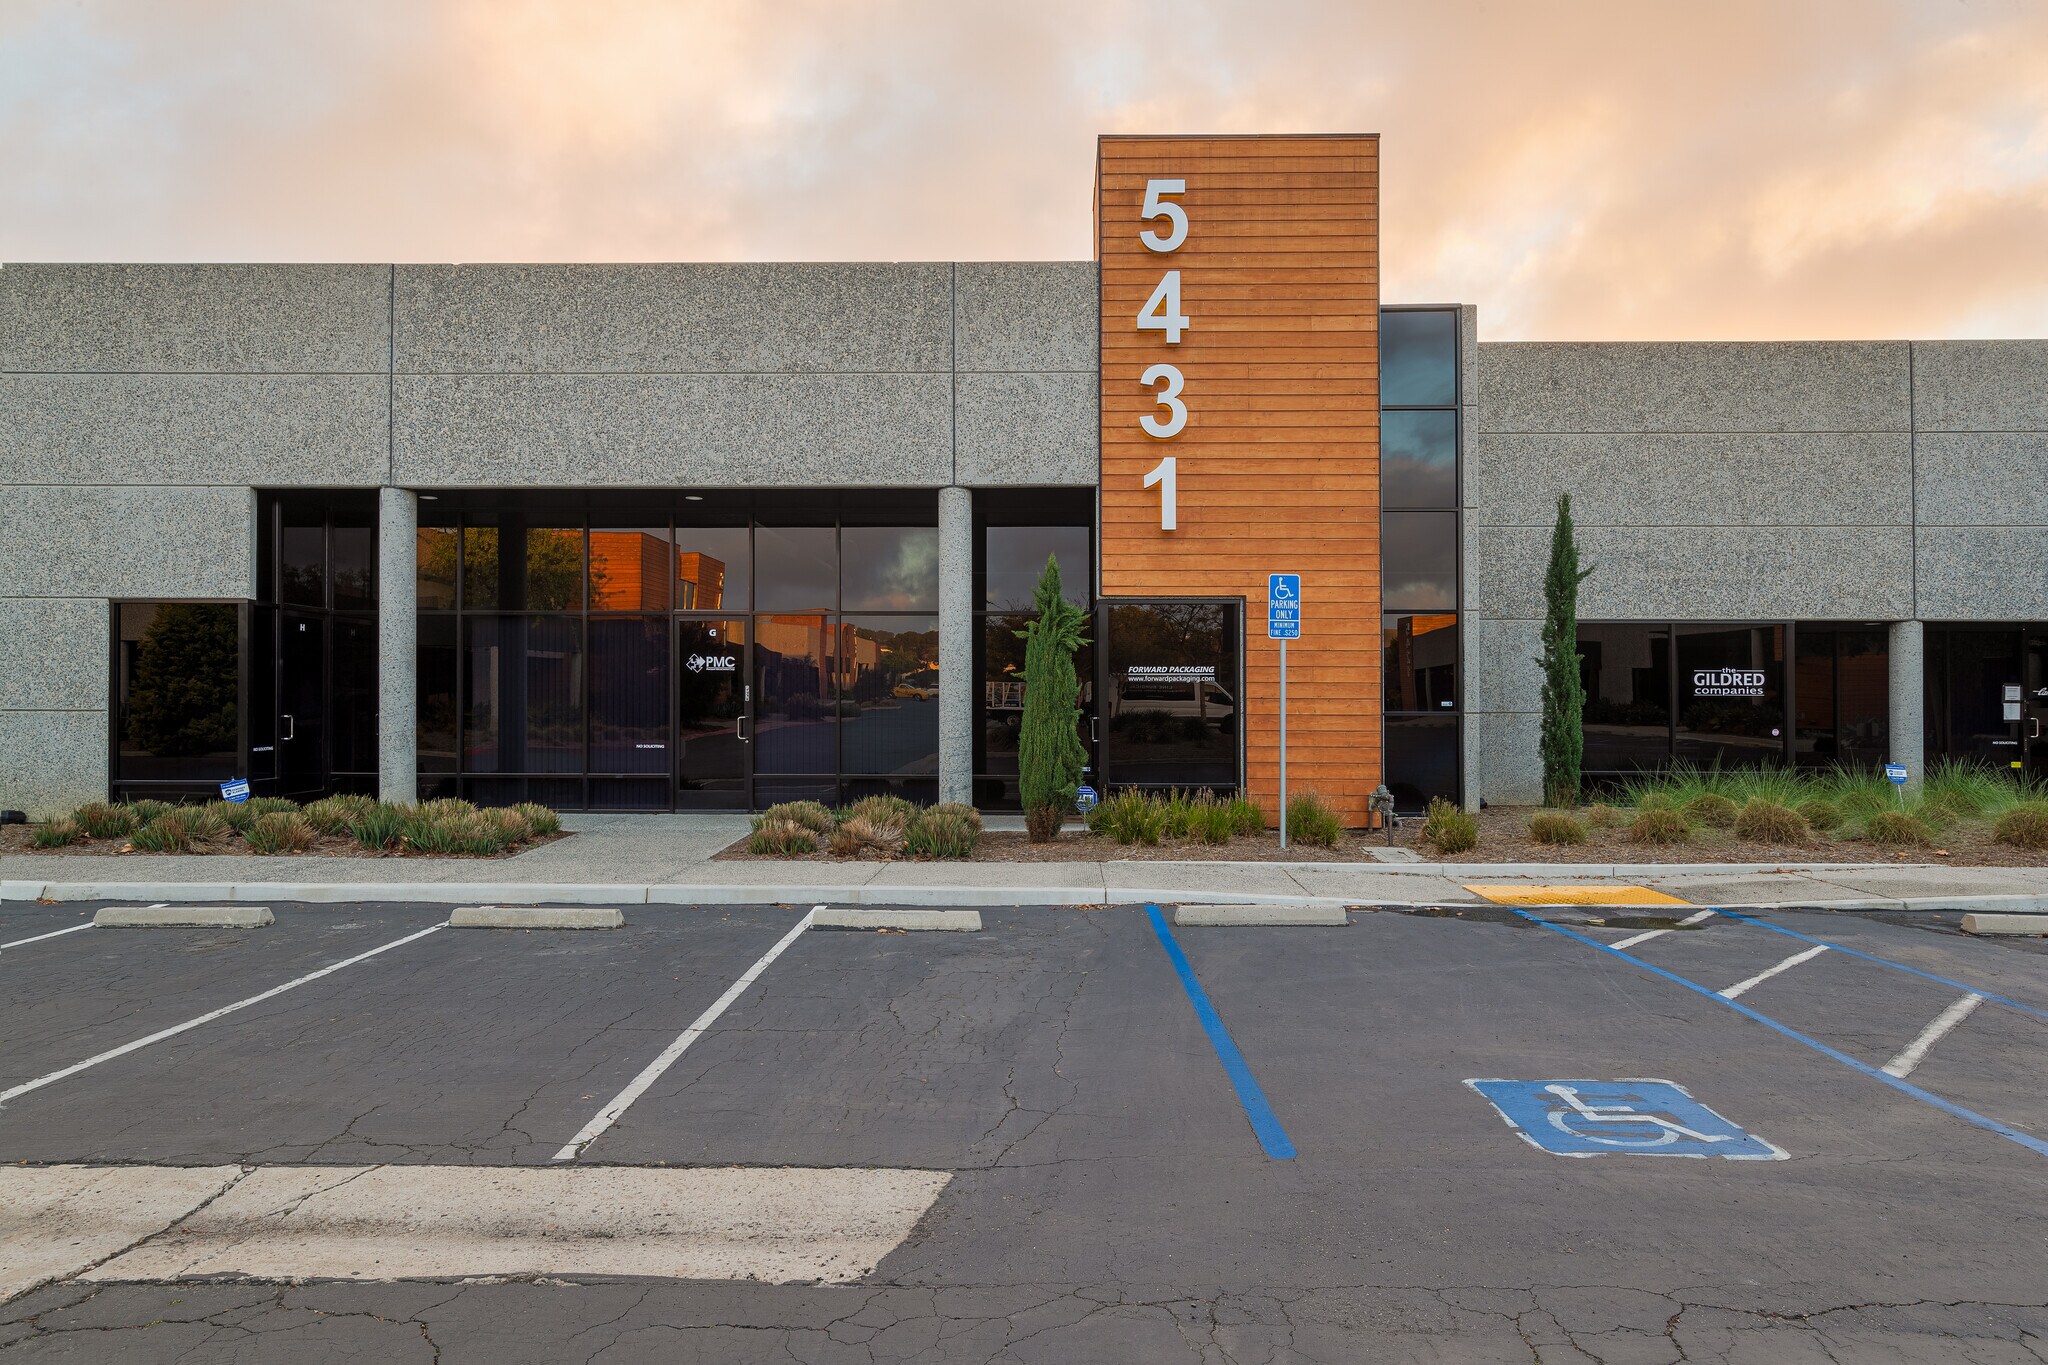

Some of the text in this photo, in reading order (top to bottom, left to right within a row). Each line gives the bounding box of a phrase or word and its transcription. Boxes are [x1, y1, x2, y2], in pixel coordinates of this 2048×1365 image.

[1136, 179, 1190, 531] 5431
[1270, 600, 1298, 609] PARKING
[1275, 610, 1293, 619] ONLY
[300, 623, 306, 632] H
[709, 629, 717, 637] G
[706, 656, 735, 667] PMC
[1128, 675, 1216, 684] www.forwardpackaging.com
[1693, 673, 1765, 686] GILDRED
[1694, 686, 1764, 696] companies
